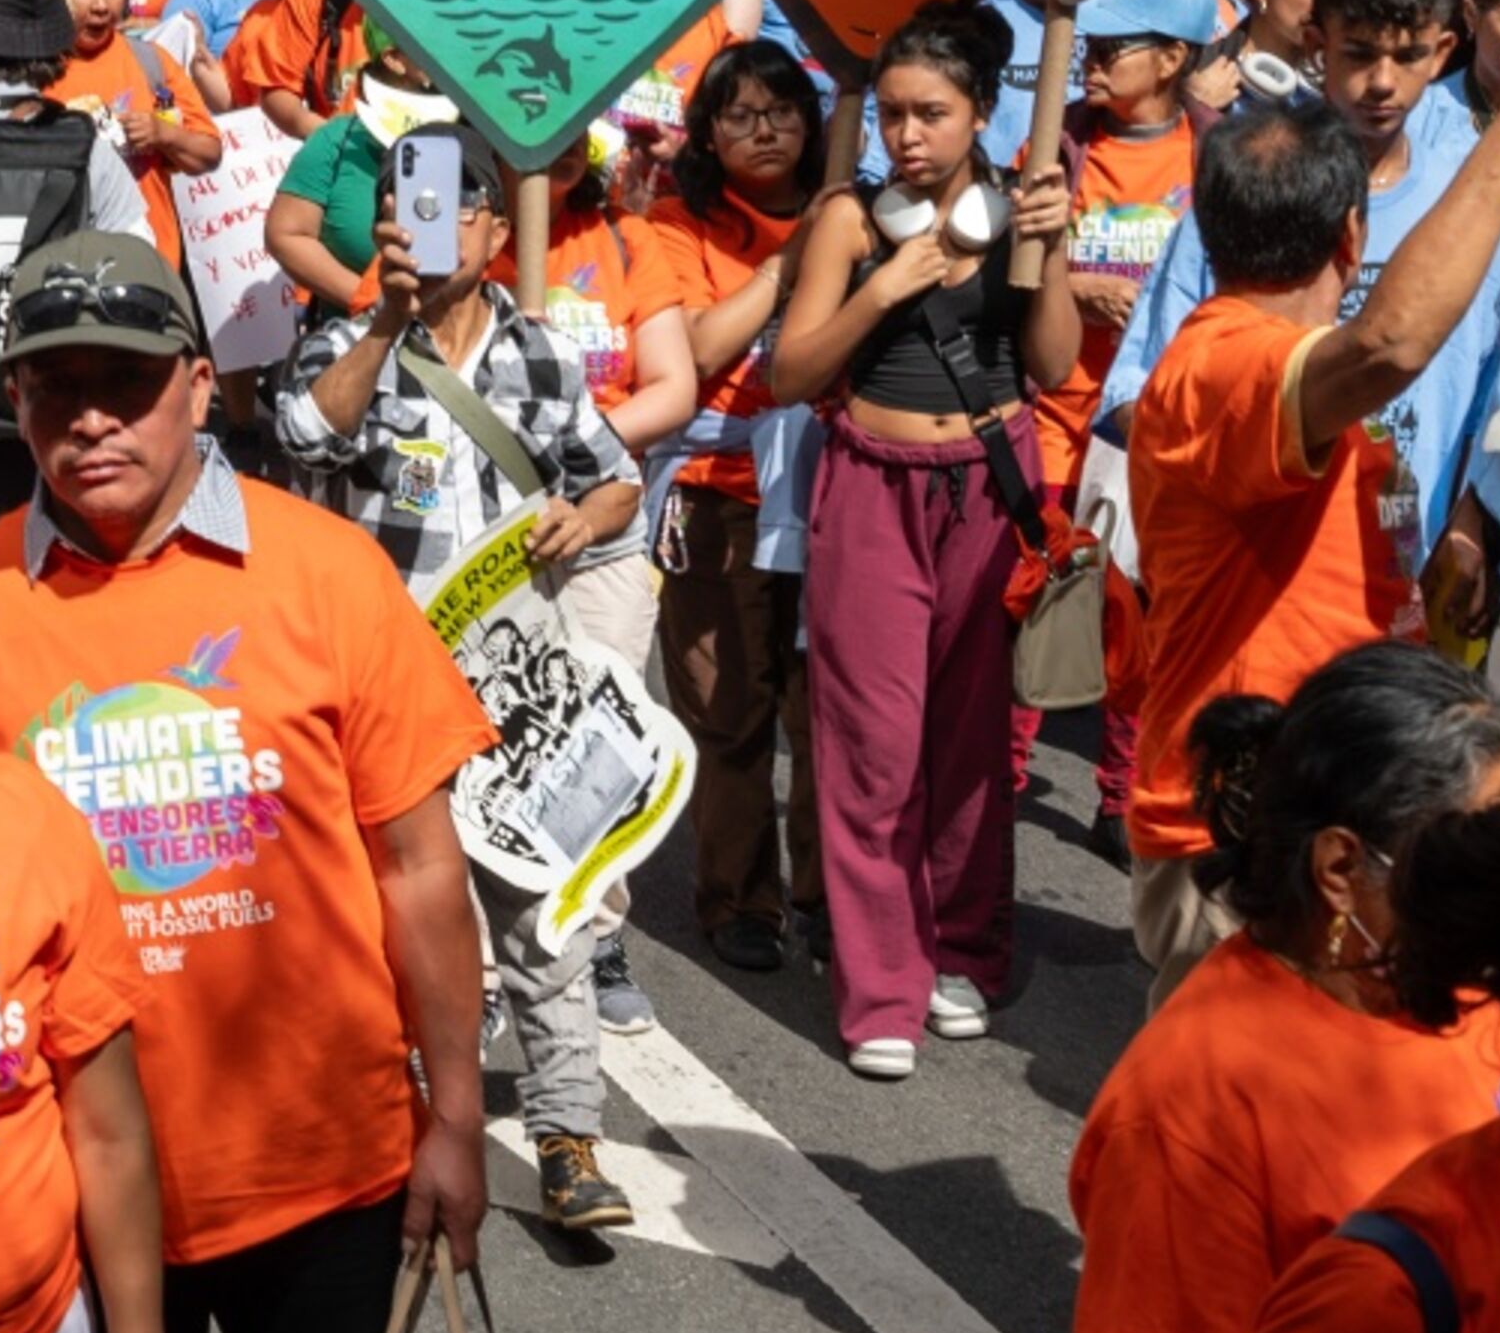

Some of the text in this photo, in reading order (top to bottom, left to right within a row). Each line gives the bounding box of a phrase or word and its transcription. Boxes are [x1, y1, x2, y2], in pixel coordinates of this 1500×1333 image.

[1077, 219, 1178, 240] CLIMAT
[35, 708, 242, 768] CLIMATE
[140, 830, 253, 868] TIERRA
[150, 902, 274, 936] FOSSIL FUELS
[161, 889, 254, 917] A WORLD
